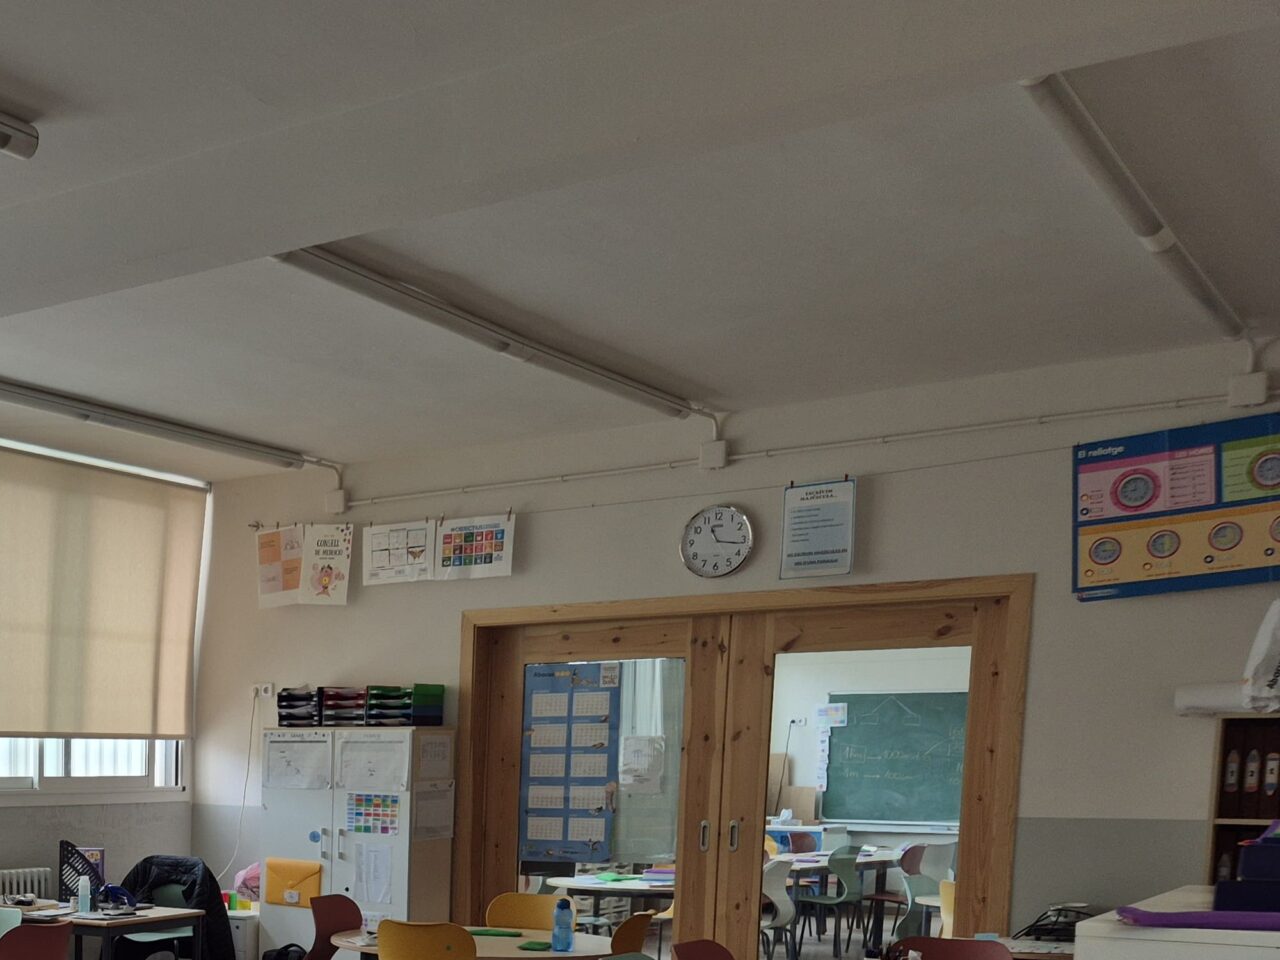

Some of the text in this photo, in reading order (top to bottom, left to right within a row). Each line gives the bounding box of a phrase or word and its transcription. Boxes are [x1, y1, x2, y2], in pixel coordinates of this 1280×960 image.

[703, 516, 711, 526] 11
[714, 511, 724, 521] 12
[730, 514, 734, 523] 1
[693, 525, 702, 535] 10
[737, 521, 743, 531] 2
[688, 538, 695, 548] 9
[740, 535, 747, 544] 3
[691, 551, 698, 561] 8
[735, 548, 741, 557] 4
[701, 559, 708, 569] 7
[712, 561, 719, 571] 6
[725, 557, 732, 567] 5
